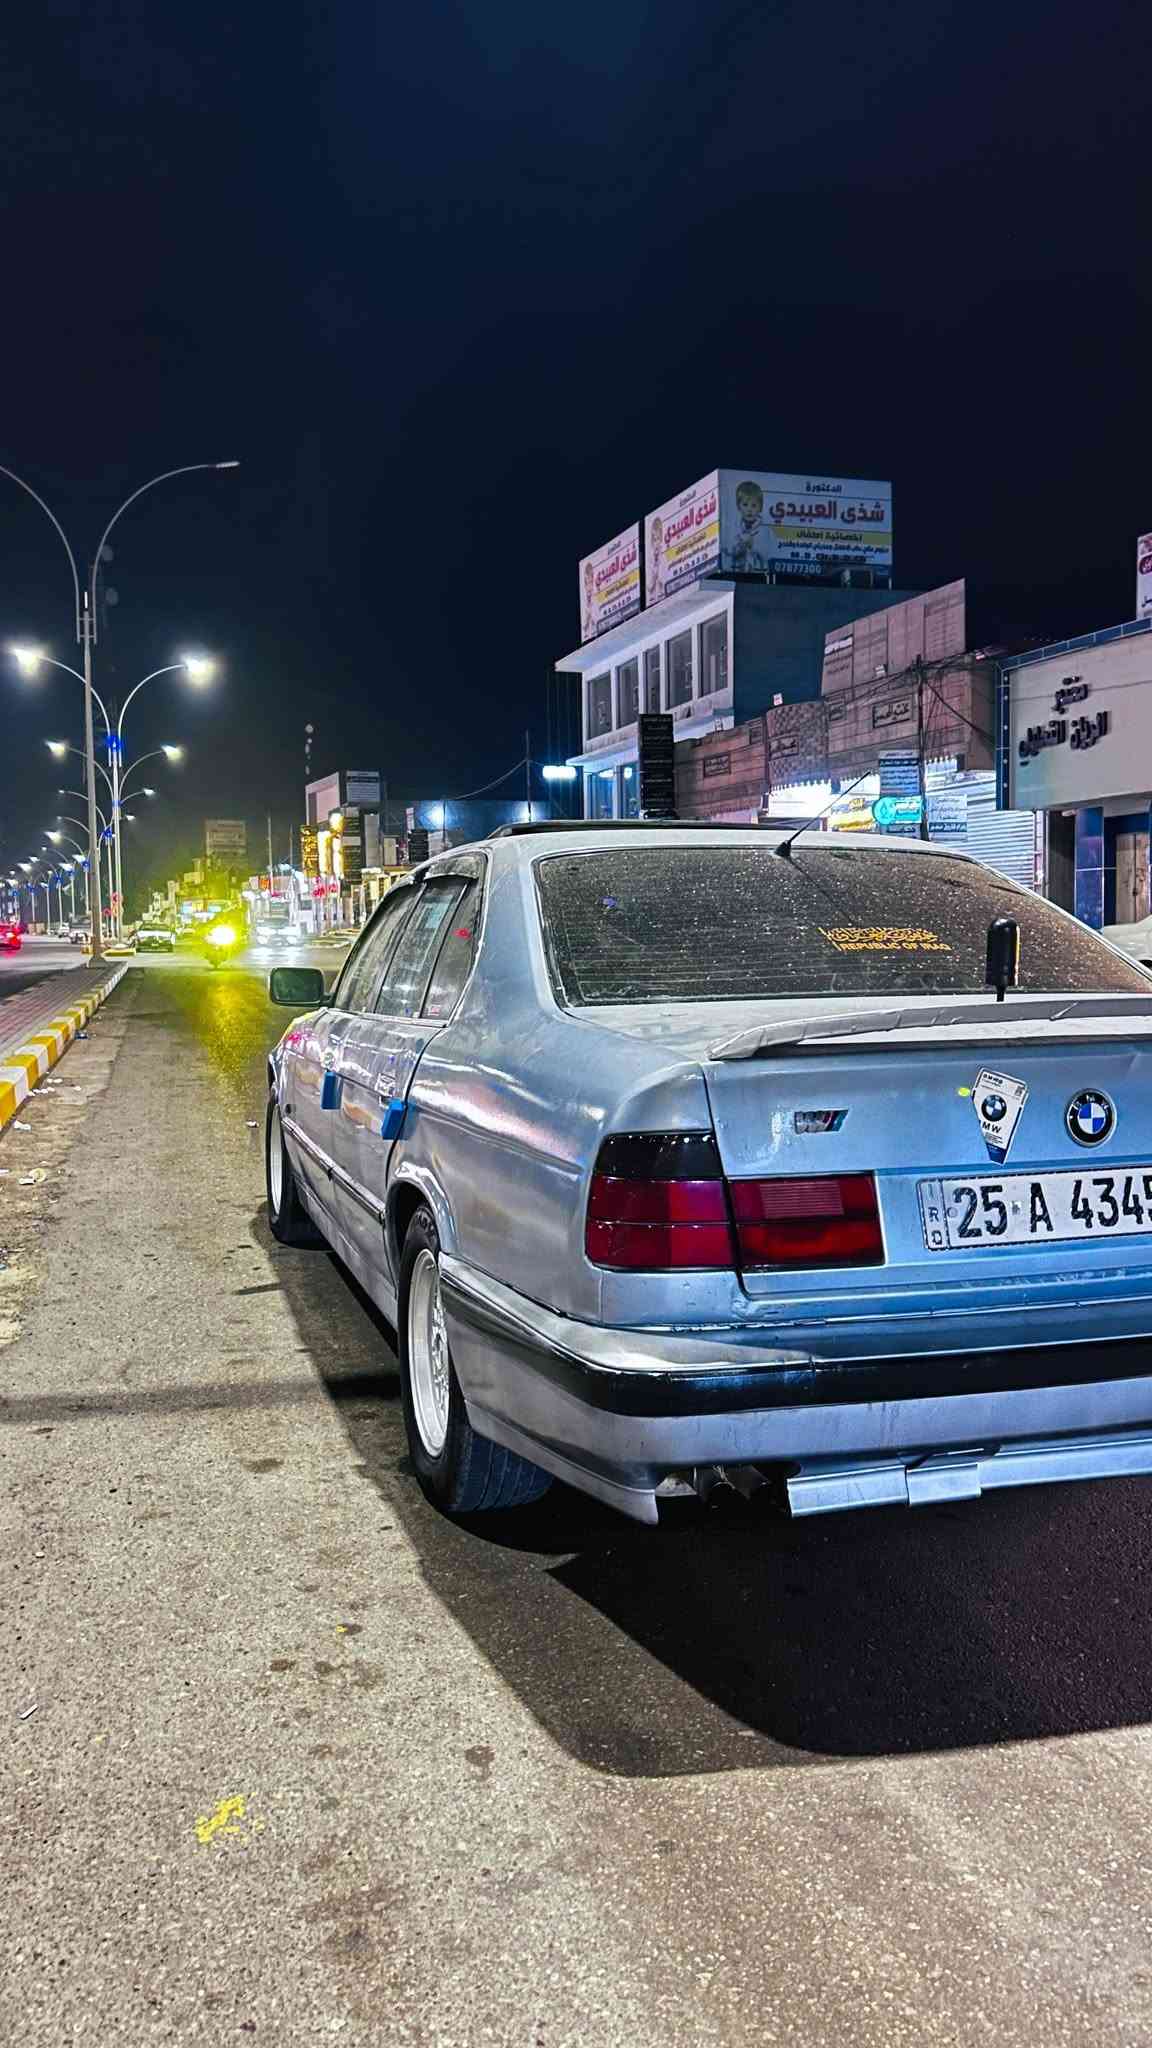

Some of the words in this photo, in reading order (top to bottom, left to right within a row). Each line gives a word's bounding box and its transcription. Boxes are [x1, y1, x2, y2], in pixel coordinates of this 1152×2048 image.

[769, 500, 837, 523] العبيدي
[952, 1185, 1008, 1239] 25
[1029, 1182, 1054, 1233] A
